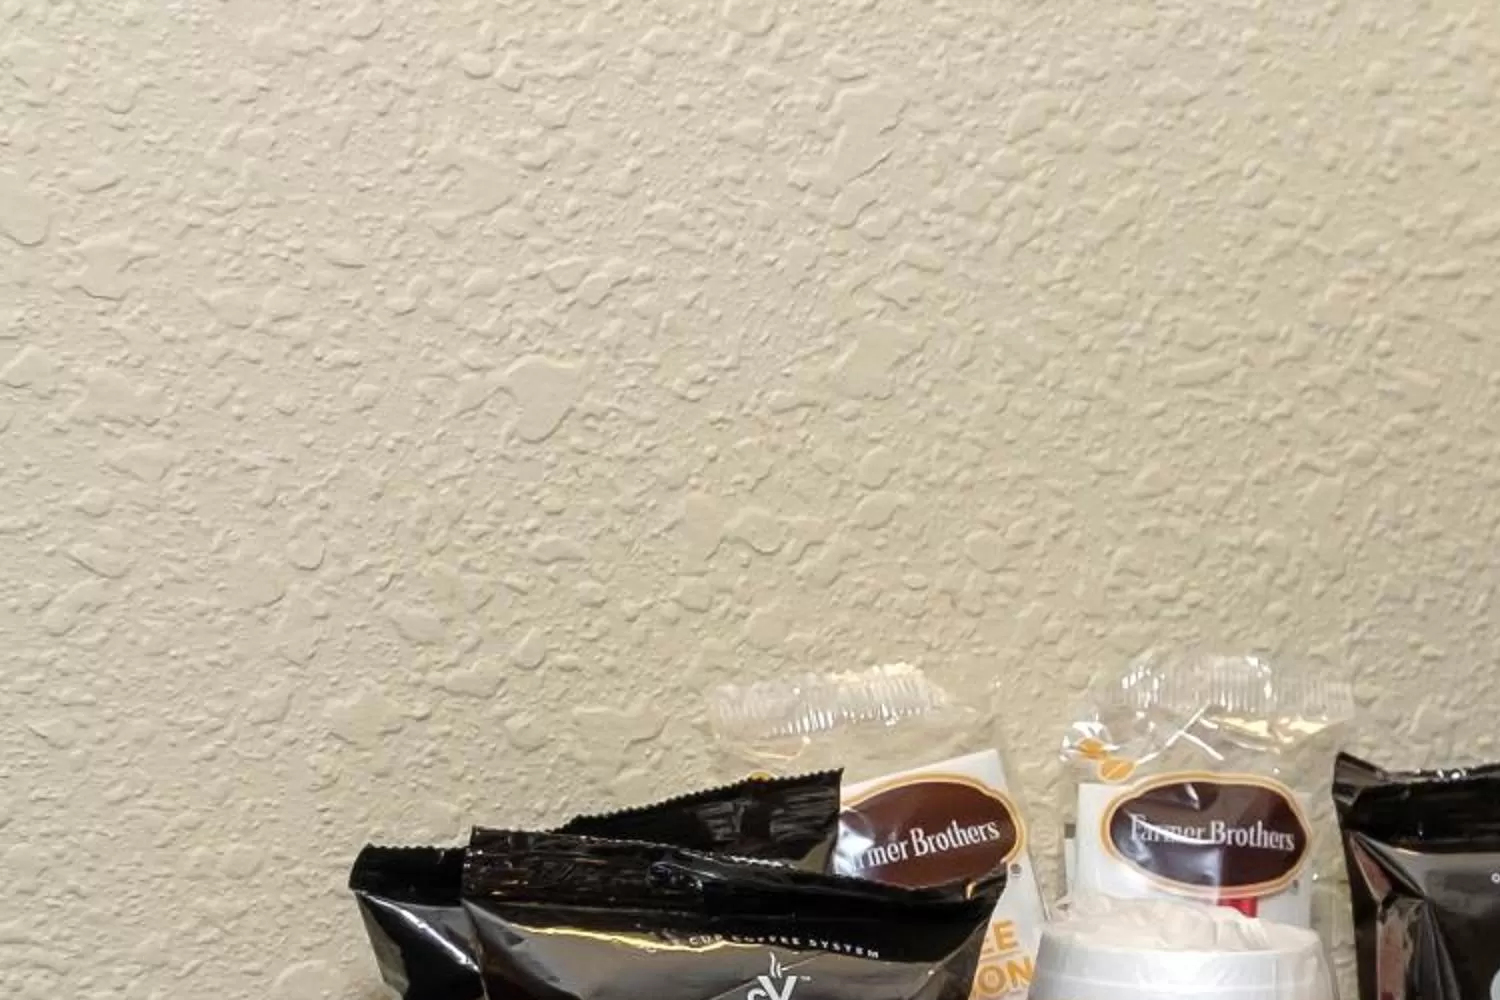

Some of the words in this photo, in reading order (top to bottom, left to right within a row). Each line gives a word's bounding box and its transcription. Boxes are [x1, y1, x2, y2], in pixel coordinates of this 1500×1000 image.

[856, 839, 910, 869] rmer
[909, 819, 1000, 858] Brothers
[1210, 819, 1296, 851] Brothers
[808, 938, 879, 959] SYSTEM
